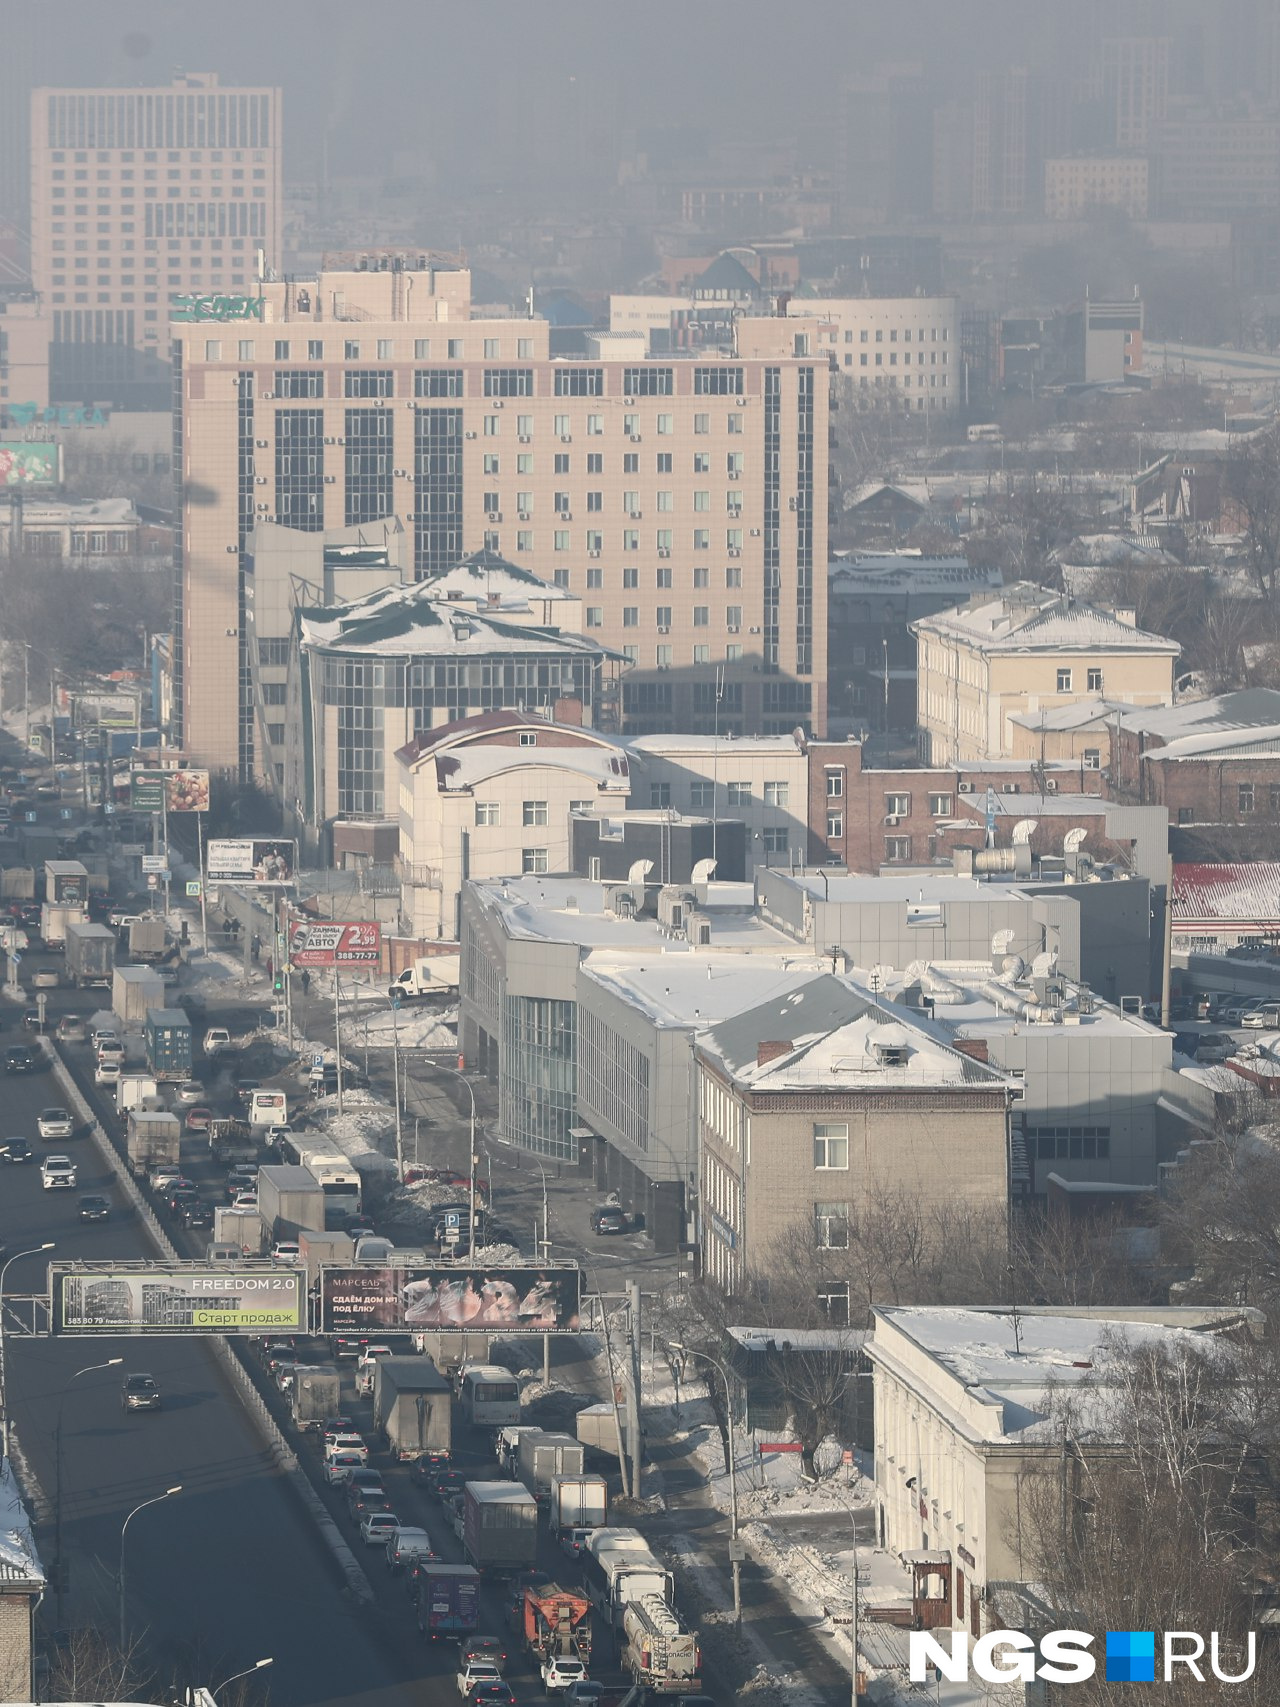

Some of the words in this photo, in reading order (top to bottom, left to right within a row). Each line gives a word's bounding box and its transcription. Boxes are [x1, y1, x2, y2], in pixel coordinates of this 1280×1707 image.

[194, 295, 266, 319] СДЭК
[43, 407, 108, 426] РЕКА
[307, 939, 335, 947] АВТО
[337, 952, 377, 960] 388-77-77
[192, 1279, 270, 1290] FREEDOM
[272, 1279, 295, 1290] 2.0
[332, 1279, 380, 1287] МАРСЕЛЬ
[332, 1294, 362, 1303] СДАЁМ
[332, 1305, 352, 1313] ПОД
[353, 1304, 375, 1312] ЁЛКУ
[198, 1312, 238, 1325] Старт
[241, 1314, 293, 1324] продаж
